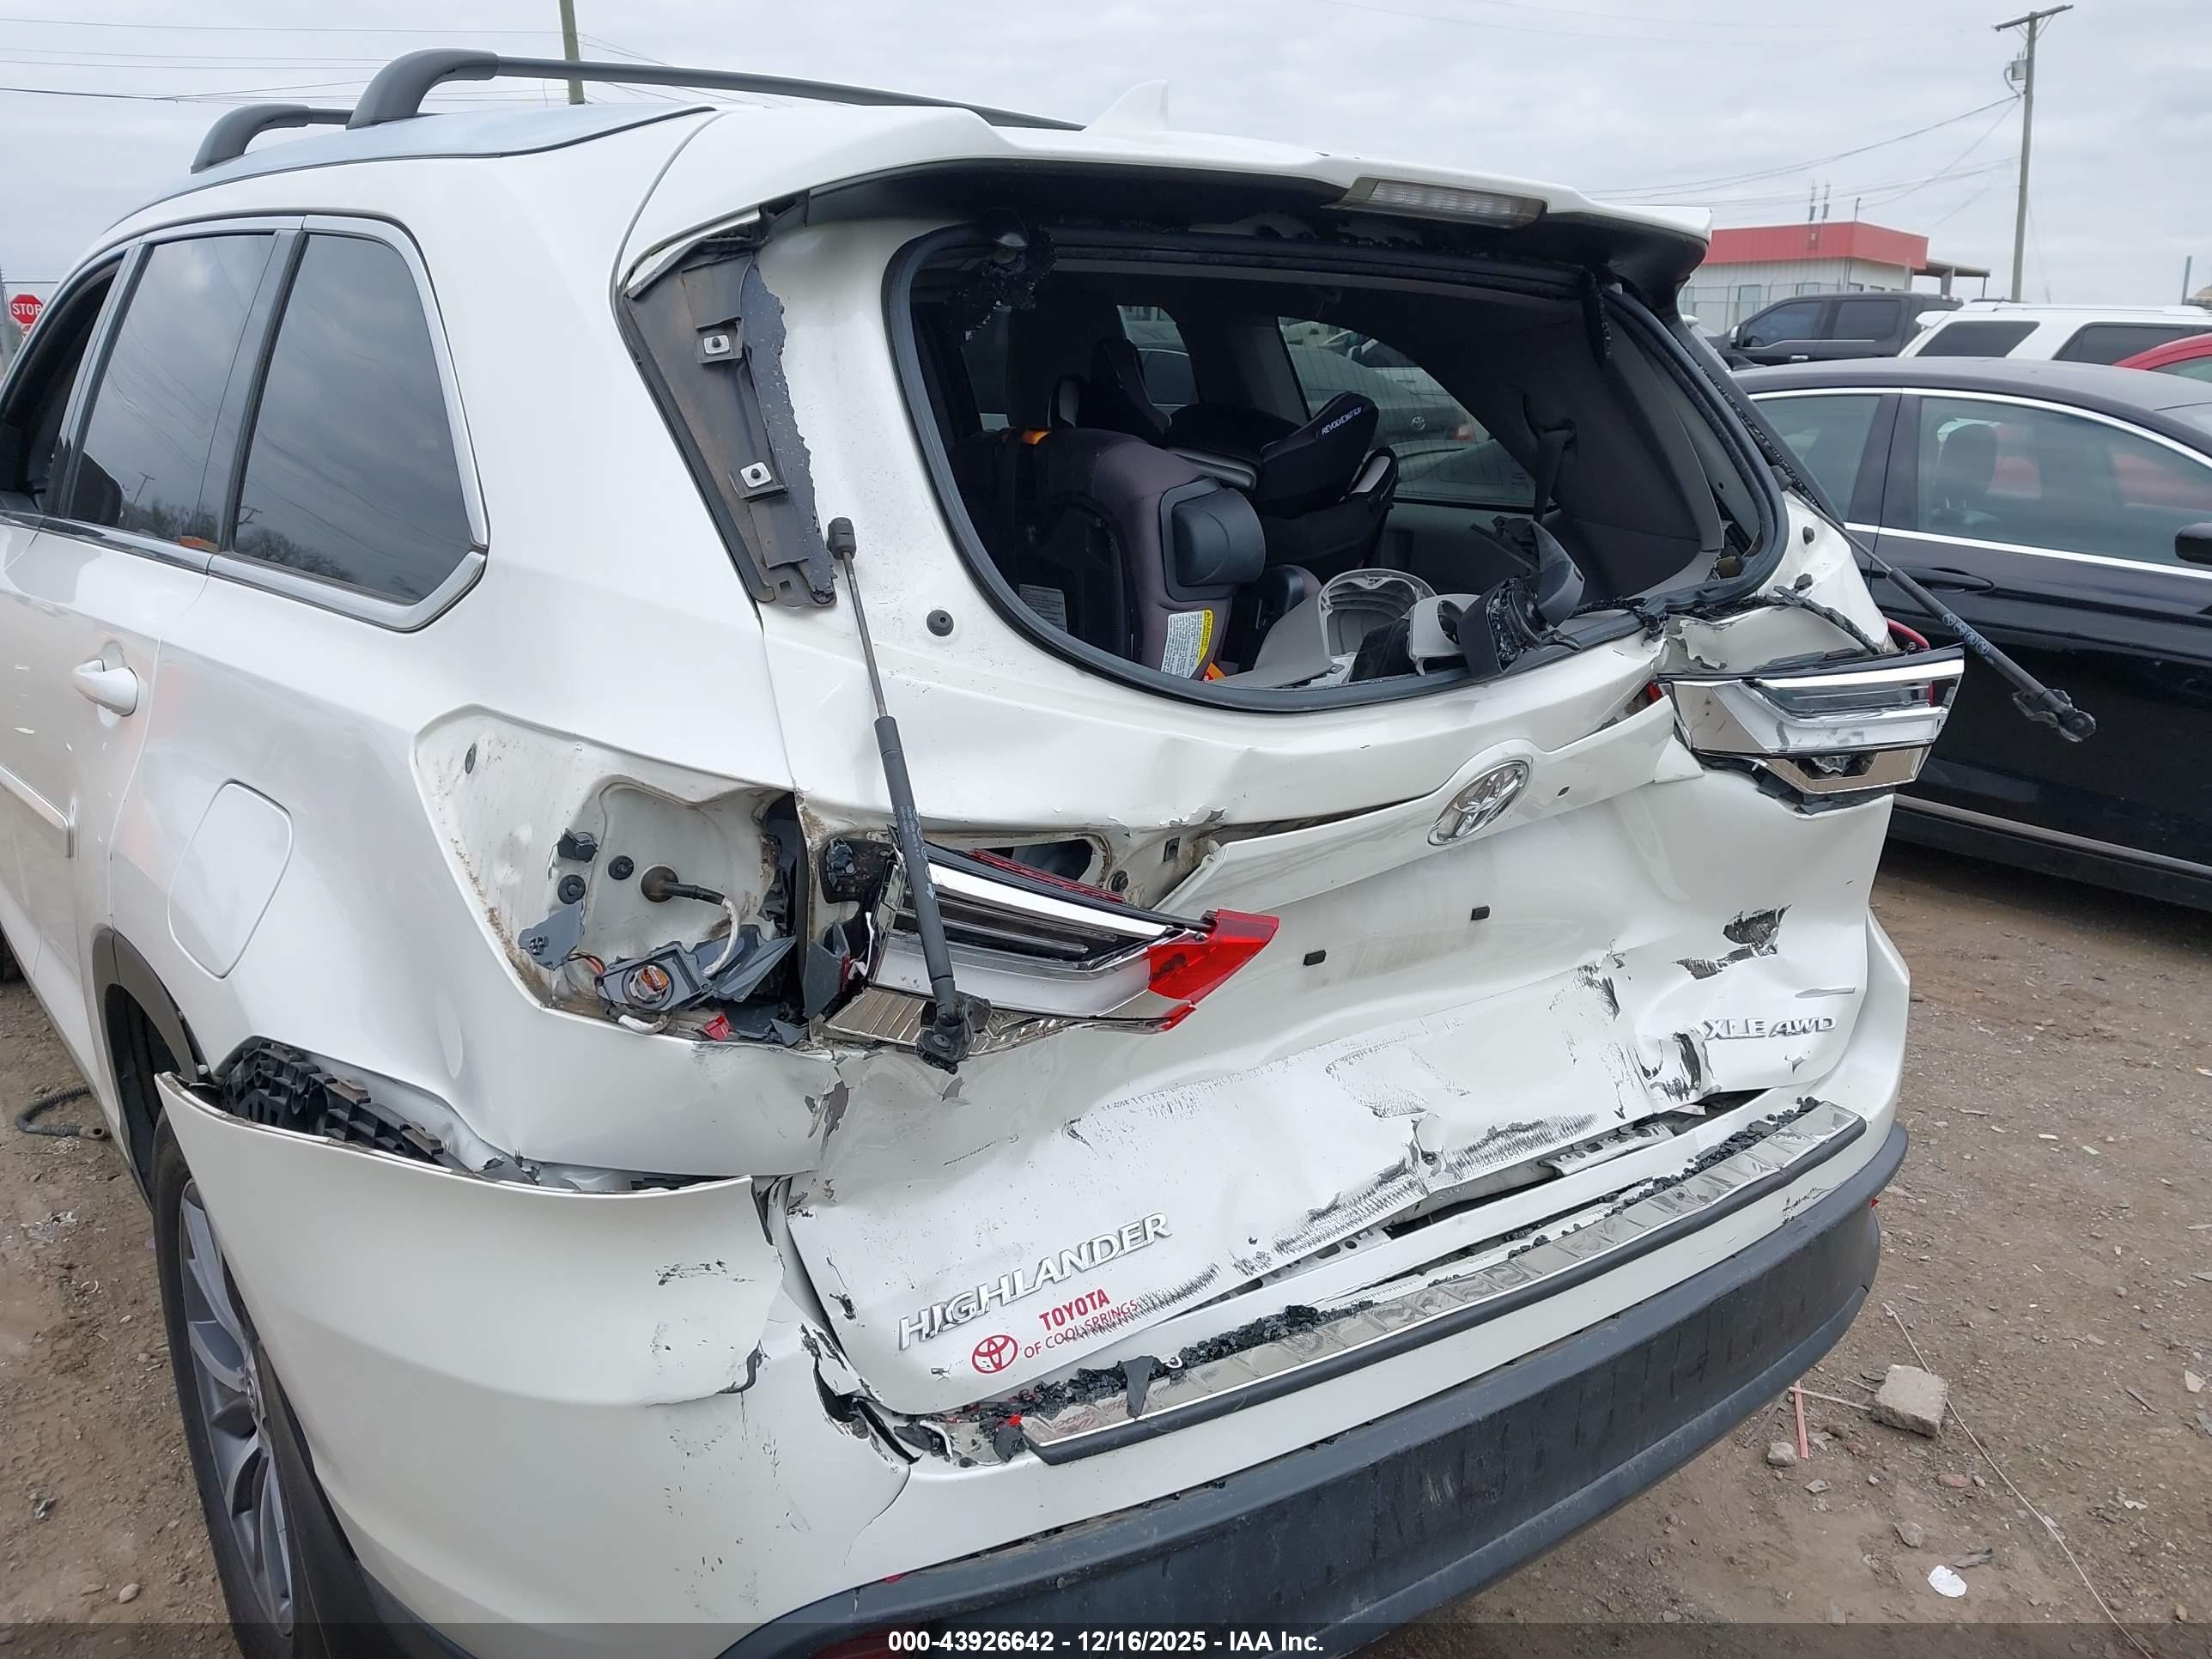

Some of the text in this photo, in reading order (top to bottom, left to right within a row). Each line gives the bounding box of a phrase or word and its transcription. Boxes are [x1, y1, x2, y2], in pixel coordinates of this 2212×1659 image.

[12, 302, 42, 316] STOP
[1704, 1016, 1837, 1040] XLE AWD
[899, 1212, 1172, 1350] HIGHLANDER
[1024, 1341, 1042, 1358] OF
[1085, 1299, 1138, 1334] SPRINGS
[1039, 1288, 1110, 1331] TOYOTA
